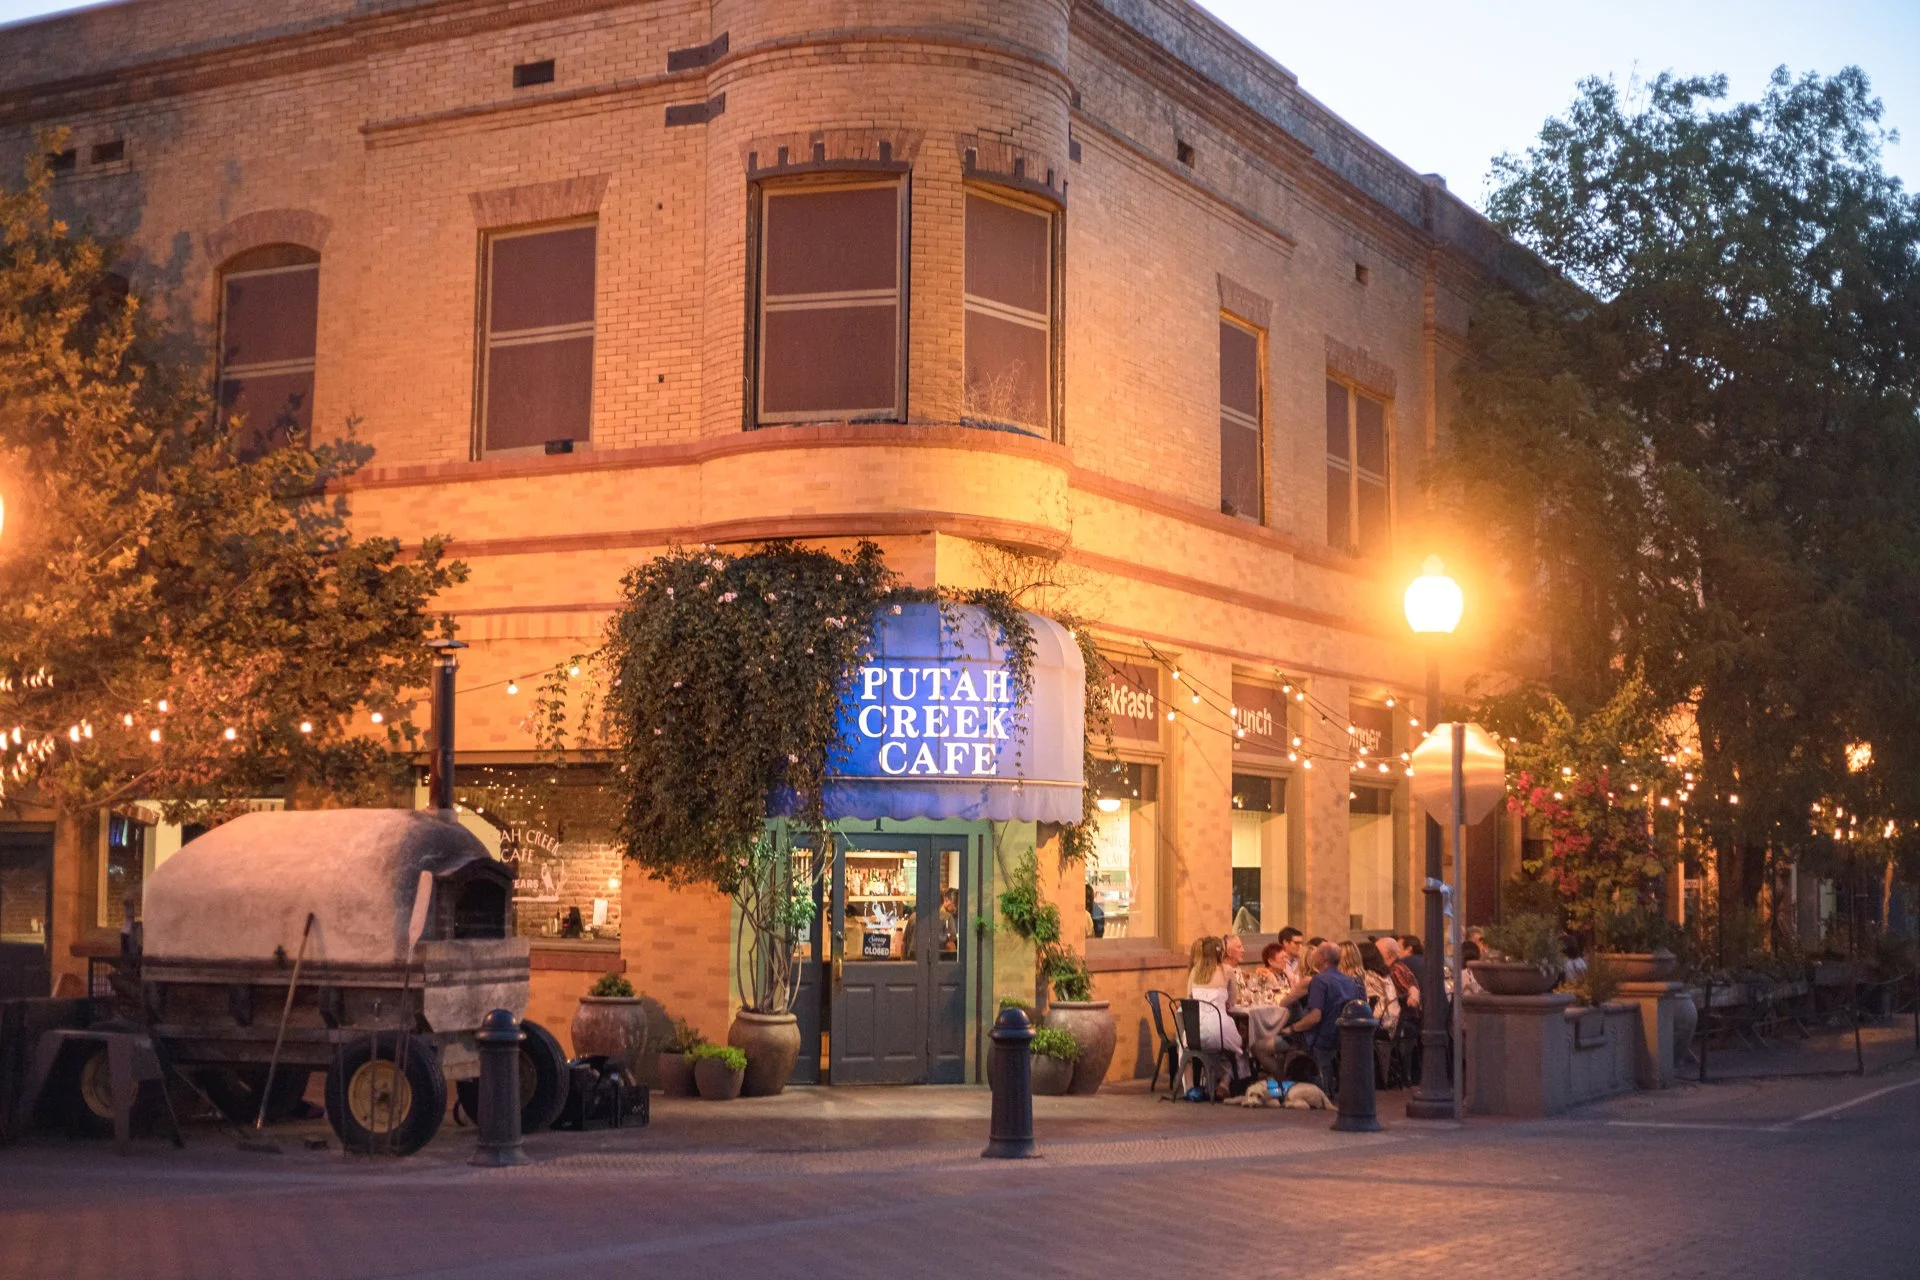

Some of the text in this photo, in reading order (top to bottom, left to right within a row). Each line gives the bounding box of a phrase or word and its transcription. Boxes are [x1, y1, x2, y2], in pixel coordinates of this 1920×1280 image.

[861, 667, 1010, 702] PUTAH
[858, 705, 1010, 739] CREEK
[1232, 707, 1272, 735] unch
[1349, 727, 1381, 751] inner
[878, 741, 997, 775] CAFE
[501, 848, 535, 863] CAFE
[512, 879, 539, 889] EARS
[865, 946, 889, 955] CLOSED
